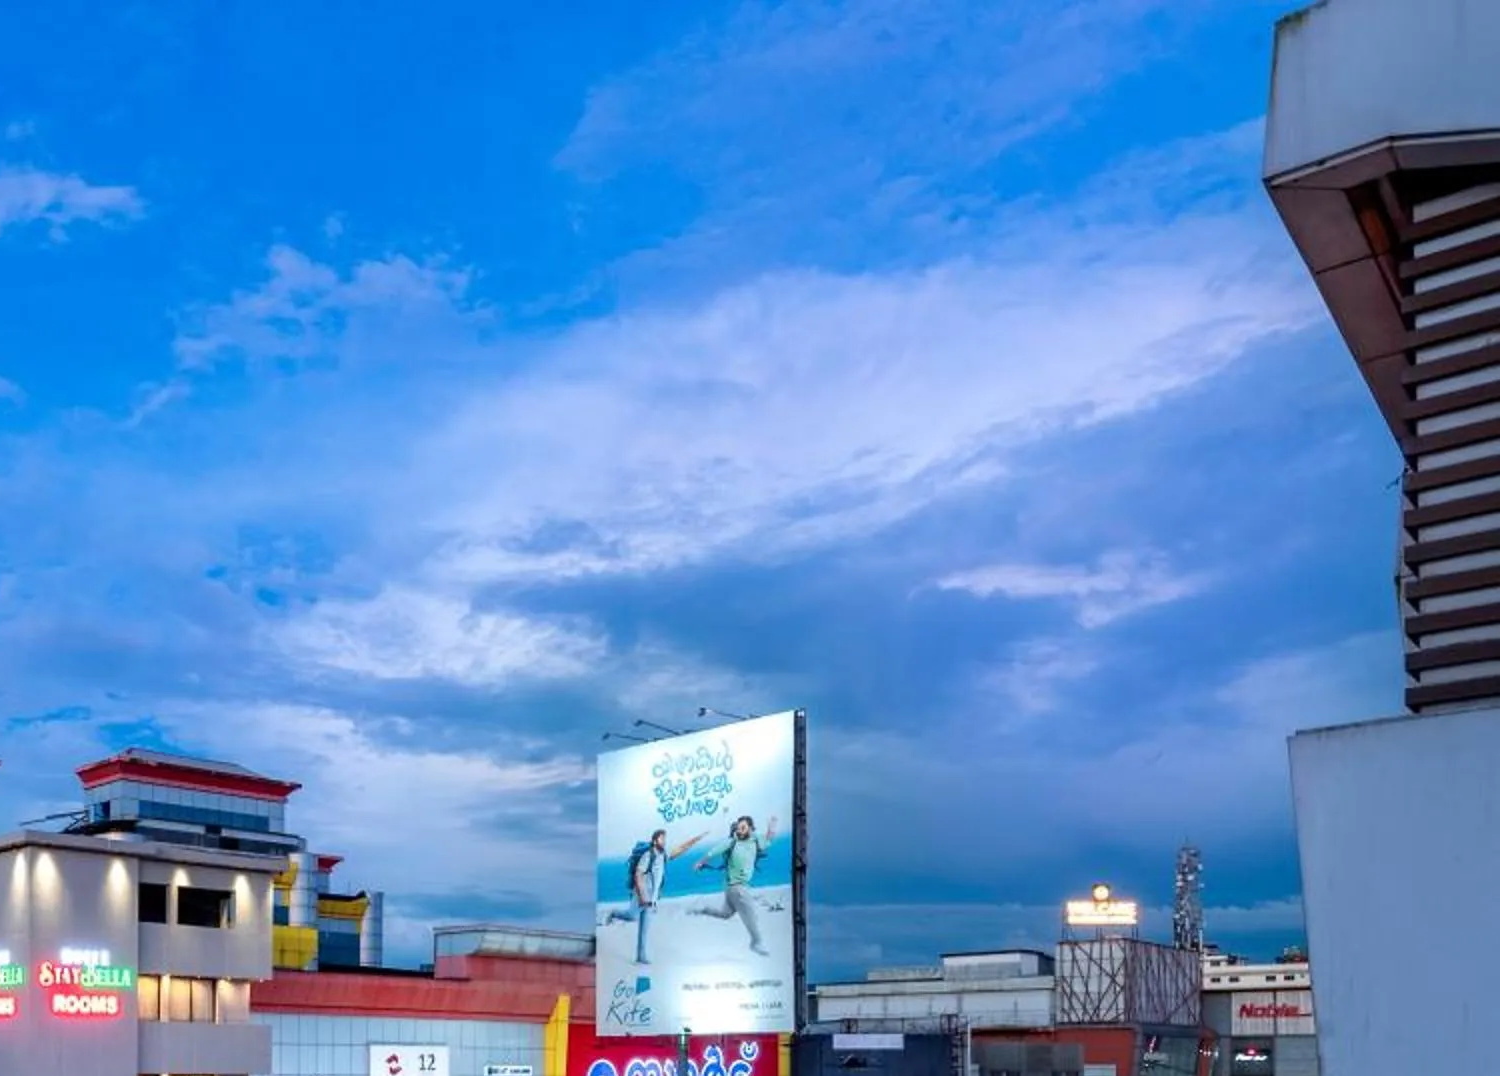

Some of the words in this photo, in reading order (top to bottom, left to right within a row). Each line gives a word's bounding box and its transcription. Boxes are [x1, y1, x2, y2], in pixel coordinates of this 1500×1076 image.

[53, 995, 118, 1014] ROOMS
[606, 1001, 652, 1025] Kite
[418, 1053, 436, 1071] 12
